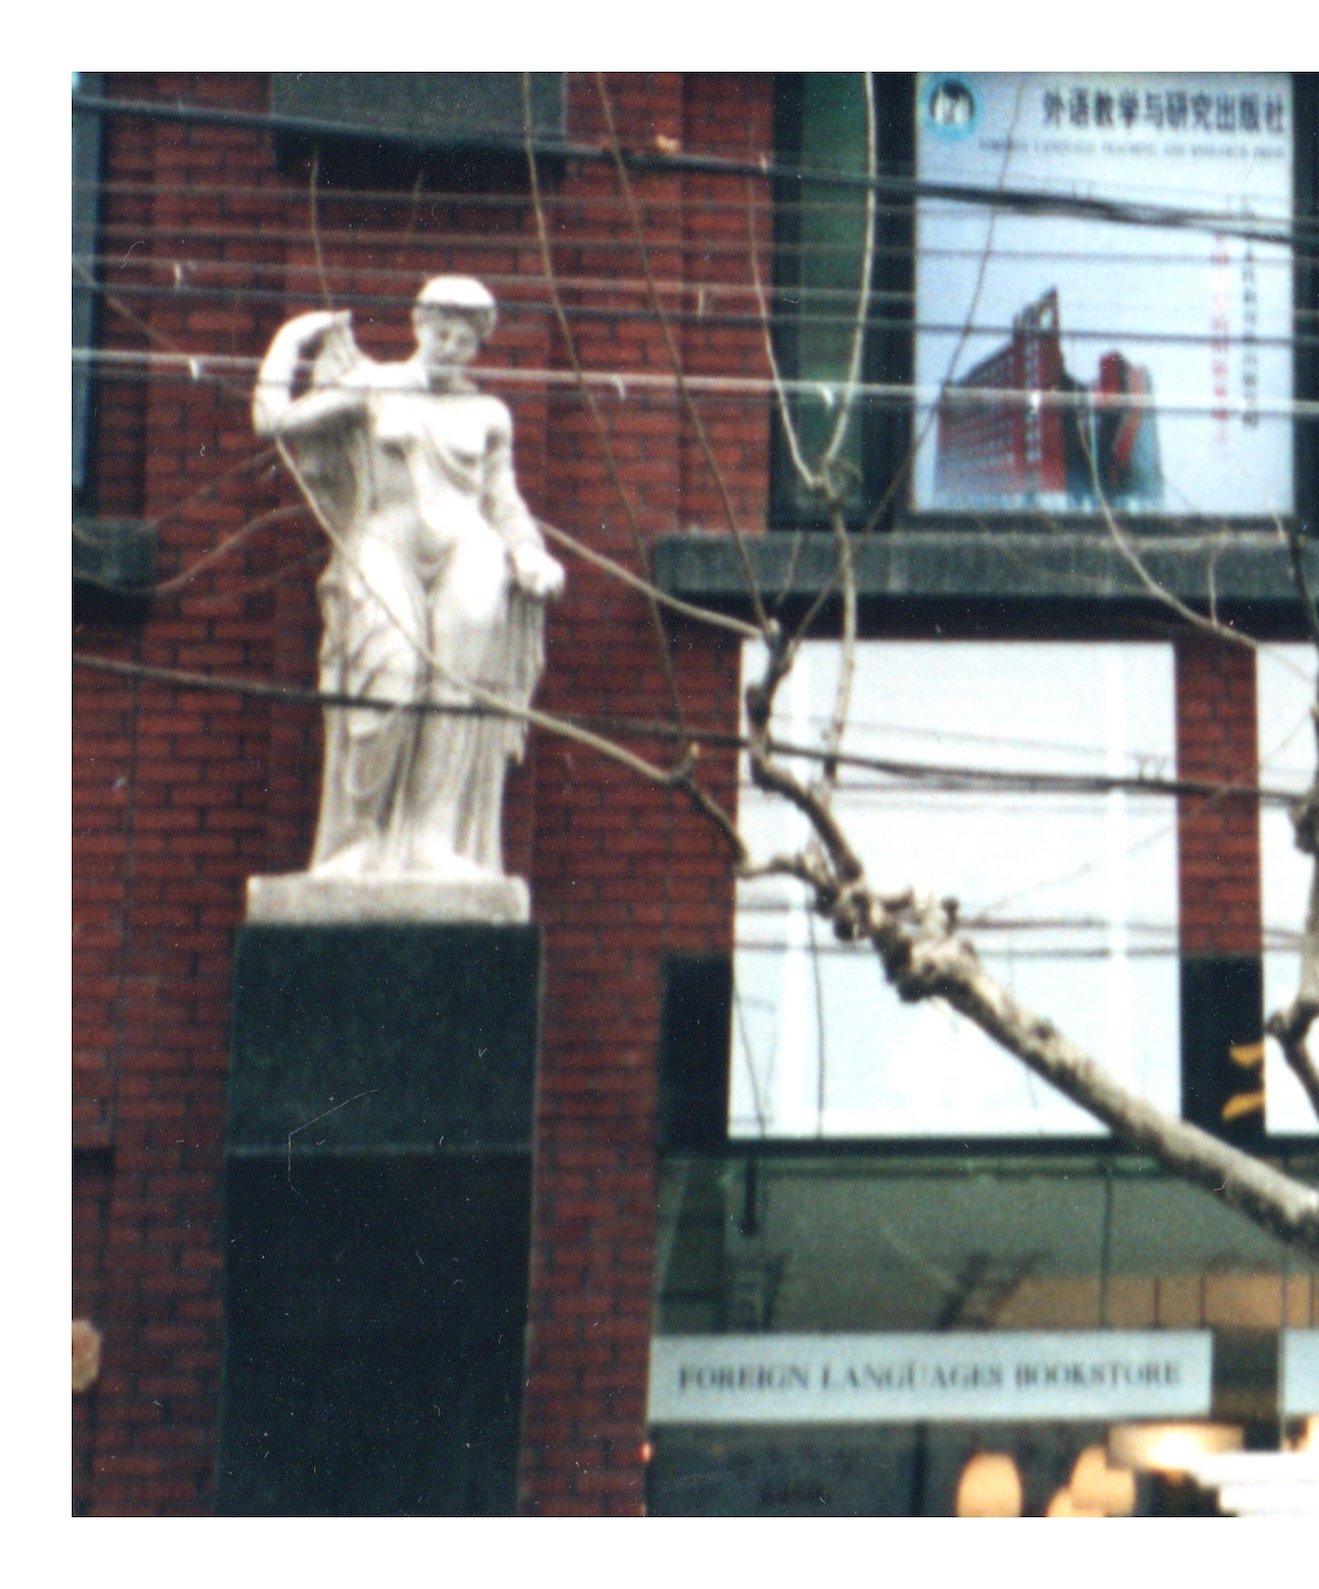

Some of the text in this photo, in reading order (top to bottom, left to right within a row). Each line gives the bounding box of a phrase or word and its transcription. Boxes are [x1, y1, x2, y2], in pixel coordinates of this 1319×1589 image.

[1043, 87, 1284, 133] 外语教学与研究出版社
[678, 1361, 1180, 1391] FOREIGN LANGUAGES BOOKSTORE
